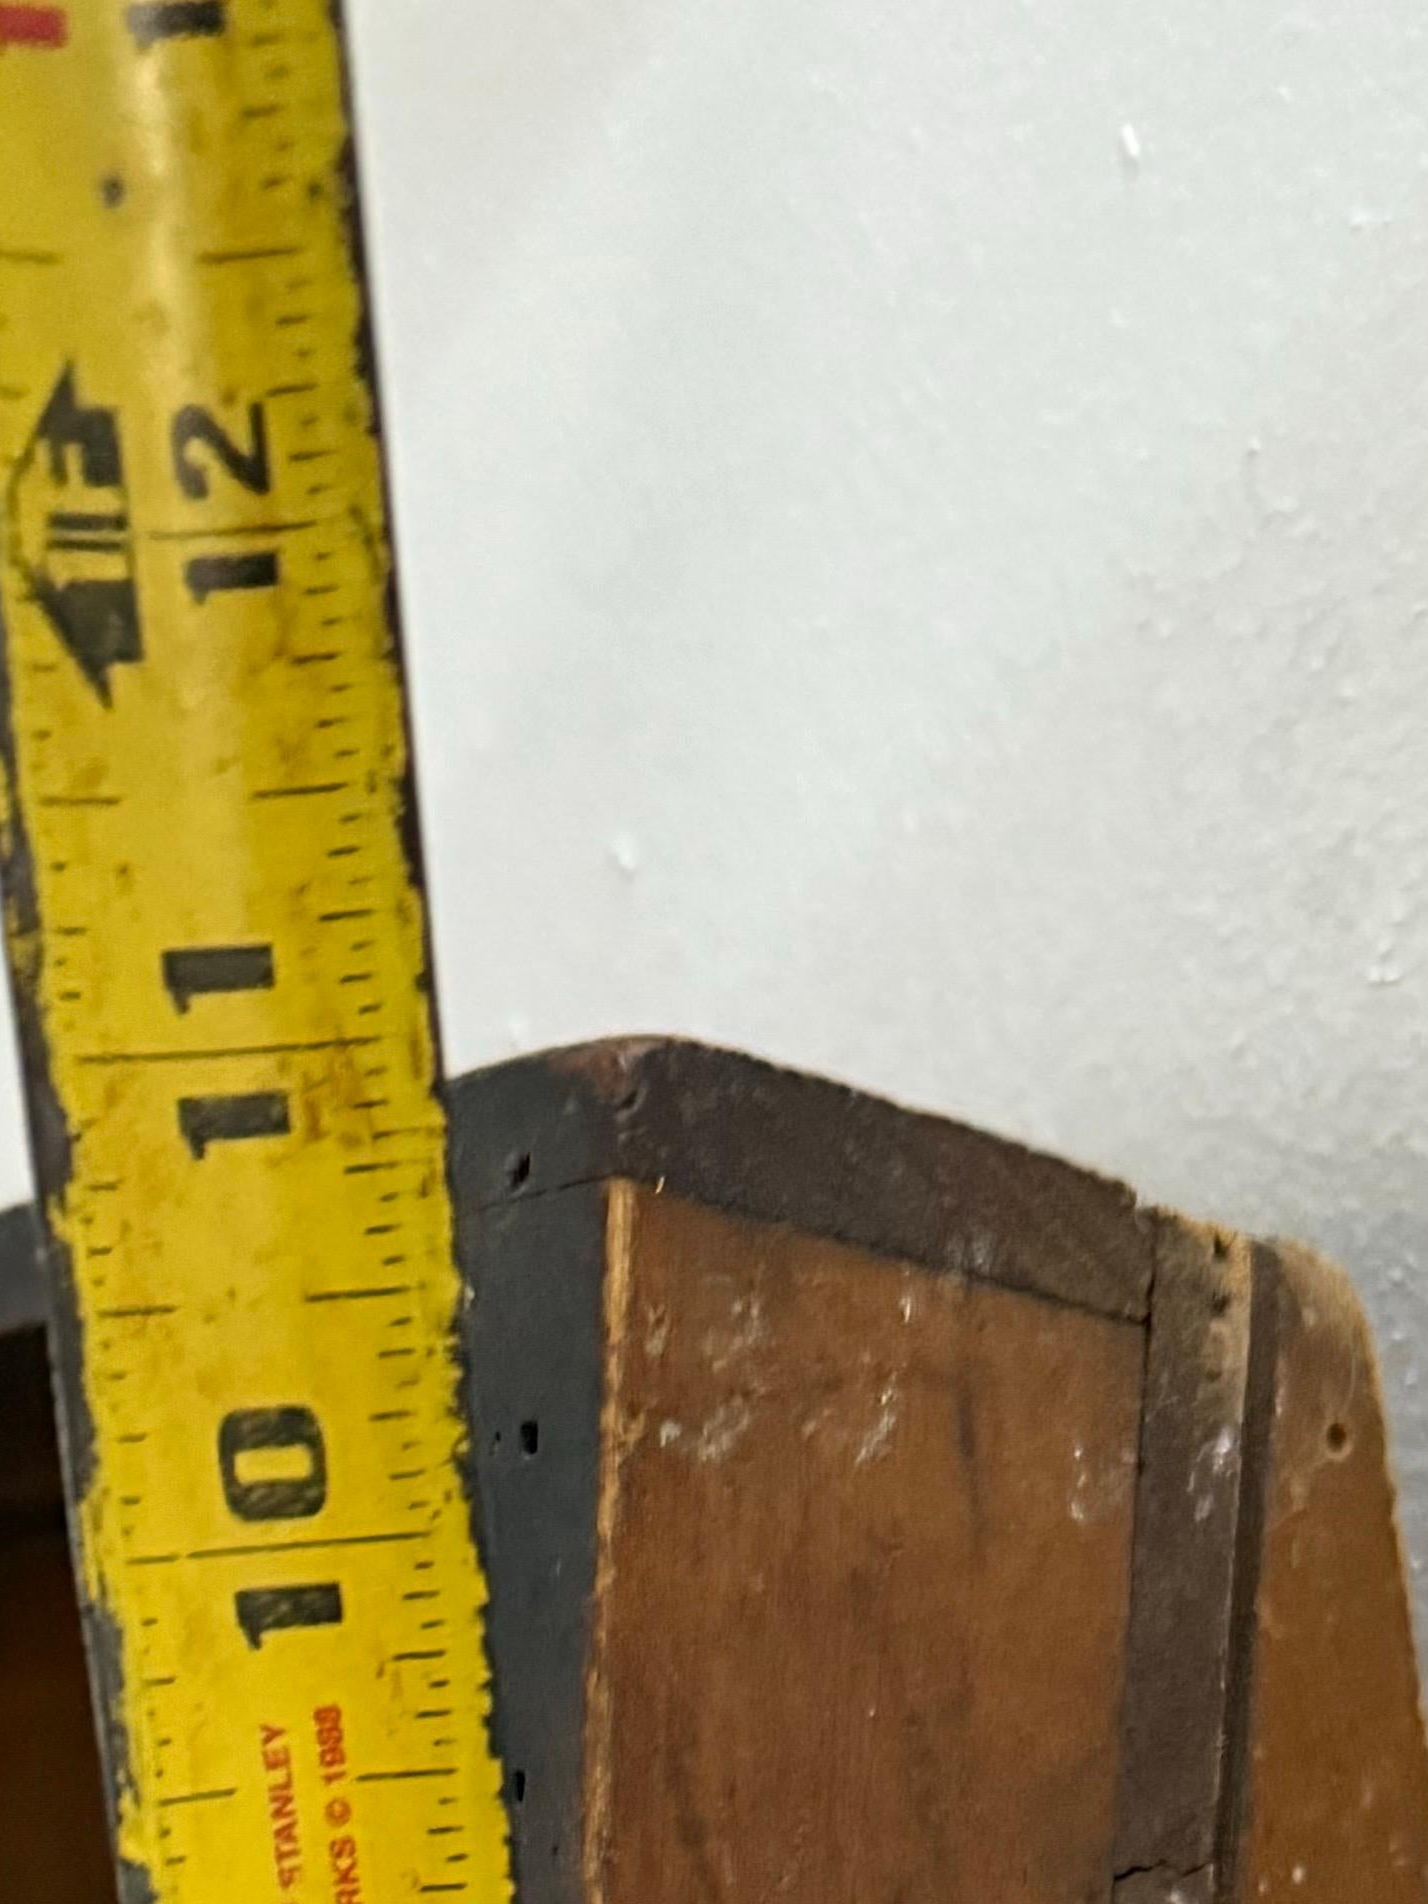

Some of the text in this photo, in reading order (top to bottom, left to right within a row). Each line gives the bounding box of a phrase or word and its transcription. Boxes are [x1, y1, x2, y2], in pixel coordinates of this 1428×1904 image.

[174, 402, 281, 606] 12
[160, 944, 292, 1160] 11
[217, 1404, 344, 1650] 10
[260, 1723, 302, 1890] STANLEY
